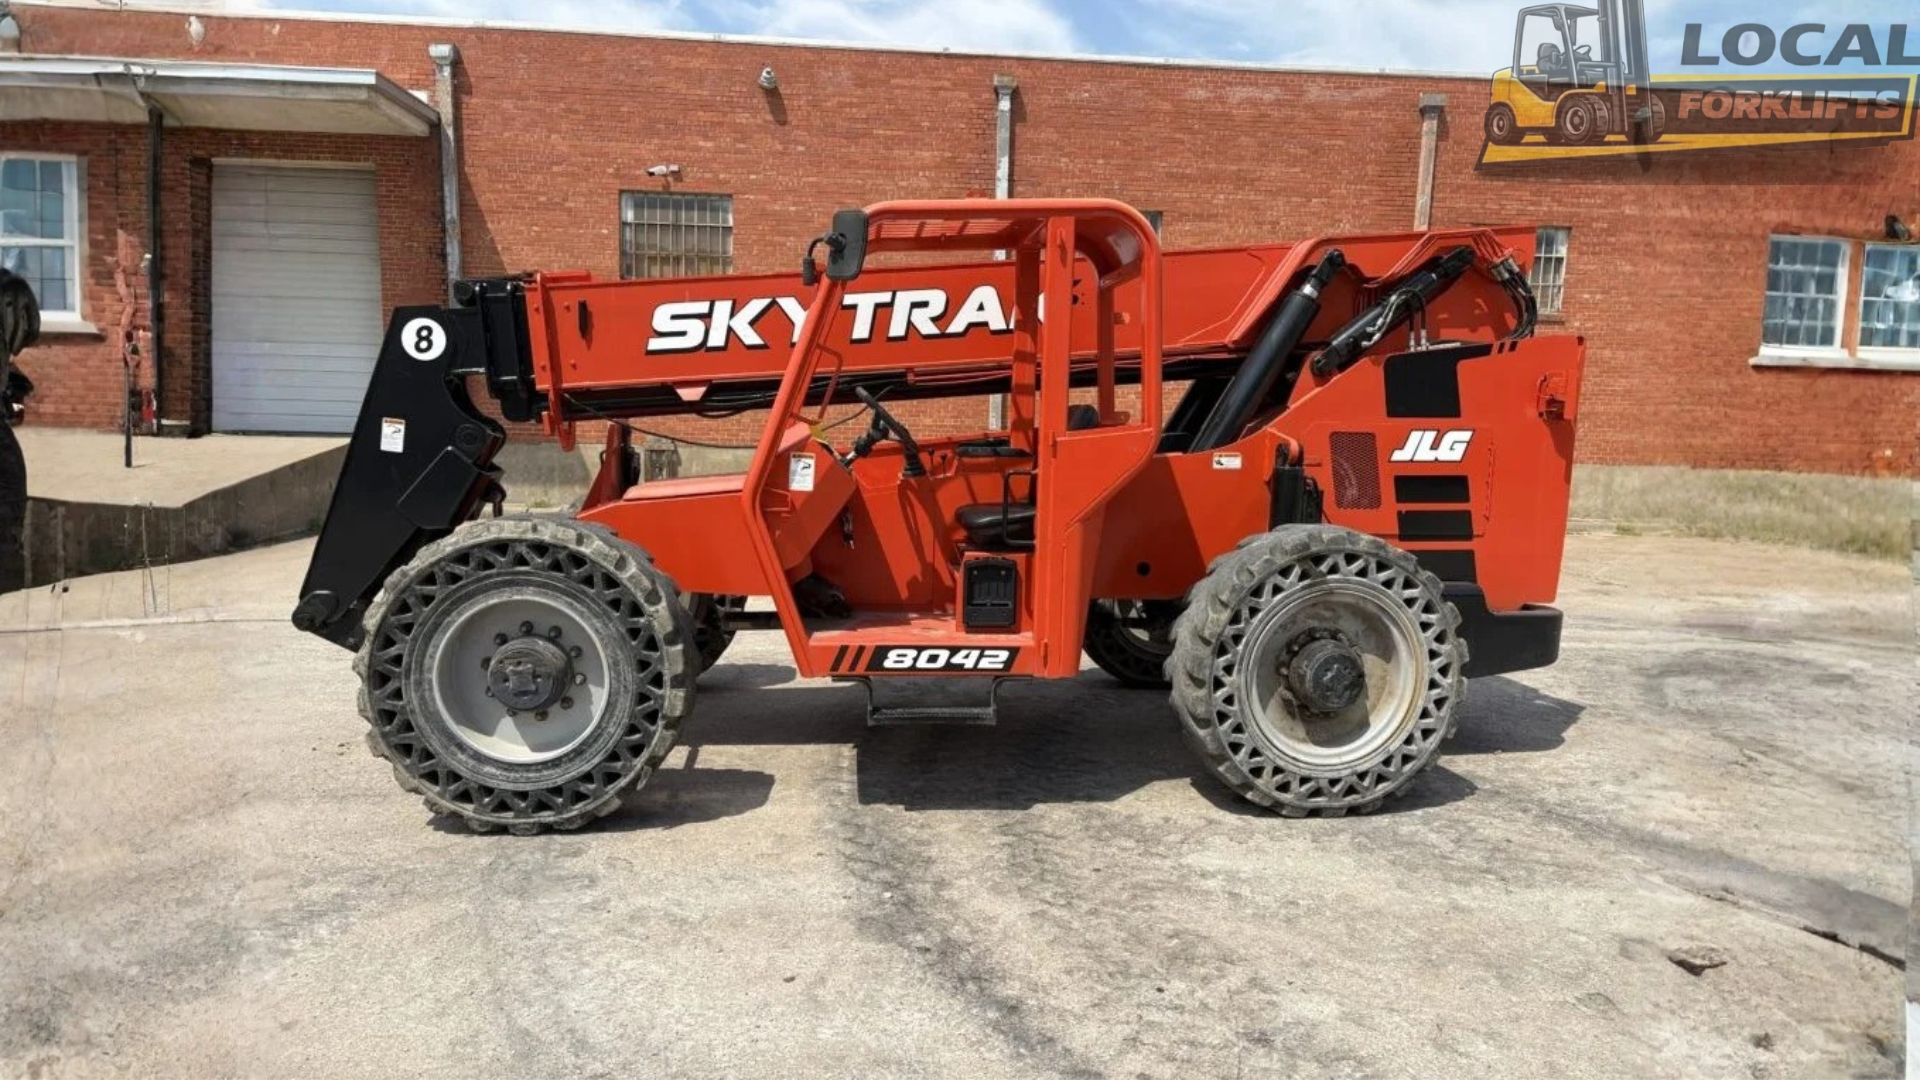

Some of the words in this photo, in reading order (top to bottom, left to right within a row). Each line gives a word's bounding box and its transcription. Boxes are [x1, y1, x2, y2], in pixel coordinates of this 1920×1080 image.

[645, 285, 1046, 355] SKYTRA
[414, 325, 433, 354] 8
[1389, 429, 1475, 462] JLG
[883, 649, 1010, 669] 8042
